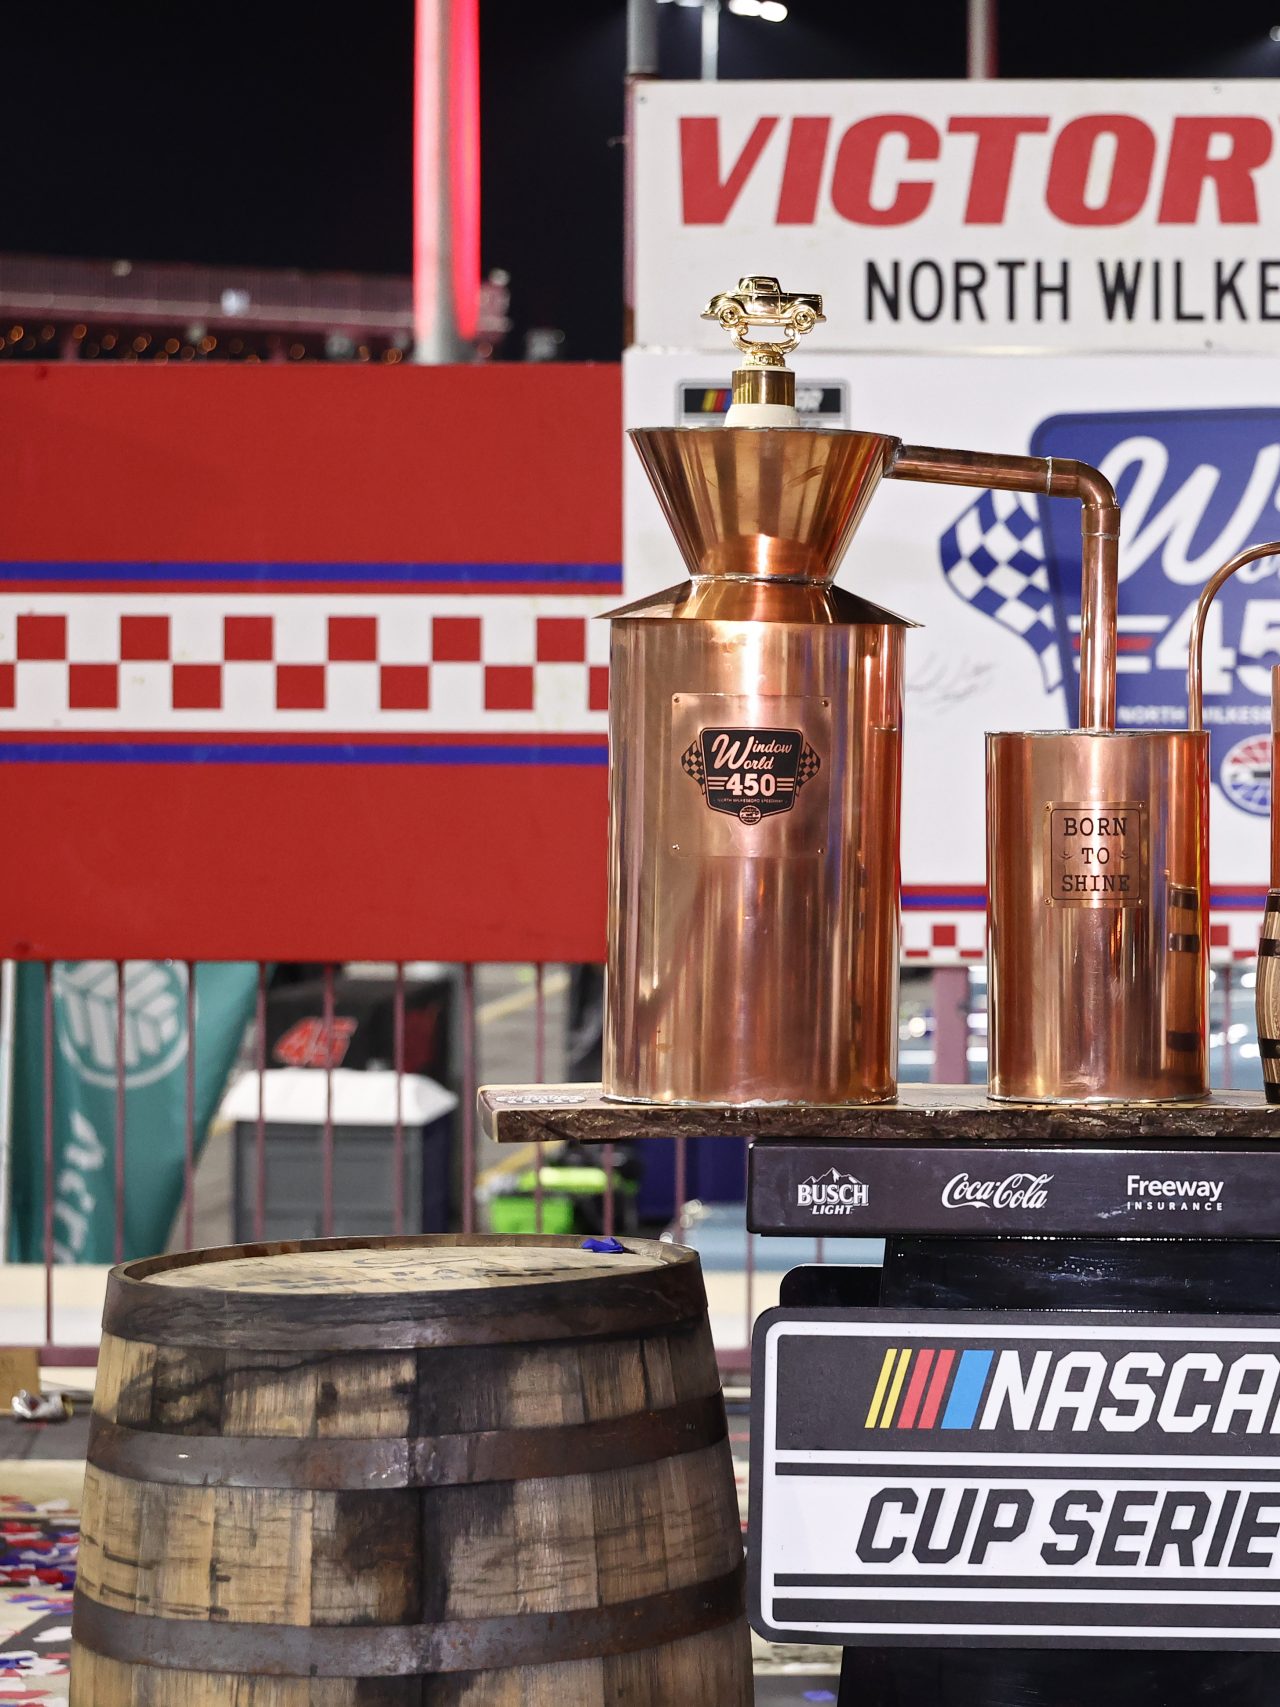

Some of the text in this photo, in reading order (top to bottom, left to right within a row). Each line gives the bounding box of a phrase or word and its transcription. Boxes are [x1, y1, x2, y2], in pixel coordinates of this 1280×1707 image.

[865, 259, 1070, 322] NORTH
[711, 733, 793, 770] Window
[725, 773, 777, 797] 450
[1063, 817, 1128, 837] BORN
[1081, 847, 1110, 865] TO
[1061, 874, 1131, 892] SHINE
[797, 1184, 869, 1206] BUSCH
[941, 1172, 1055, 1209] Coca-Cola
[1126, 1174, 1225, 1201] Freeway
[811, 1205, 853, 1215] LIGHT
[1126, 1201, 1224, 1211] INSURANCE
[855, 1487, 1034, 1566] CUP
